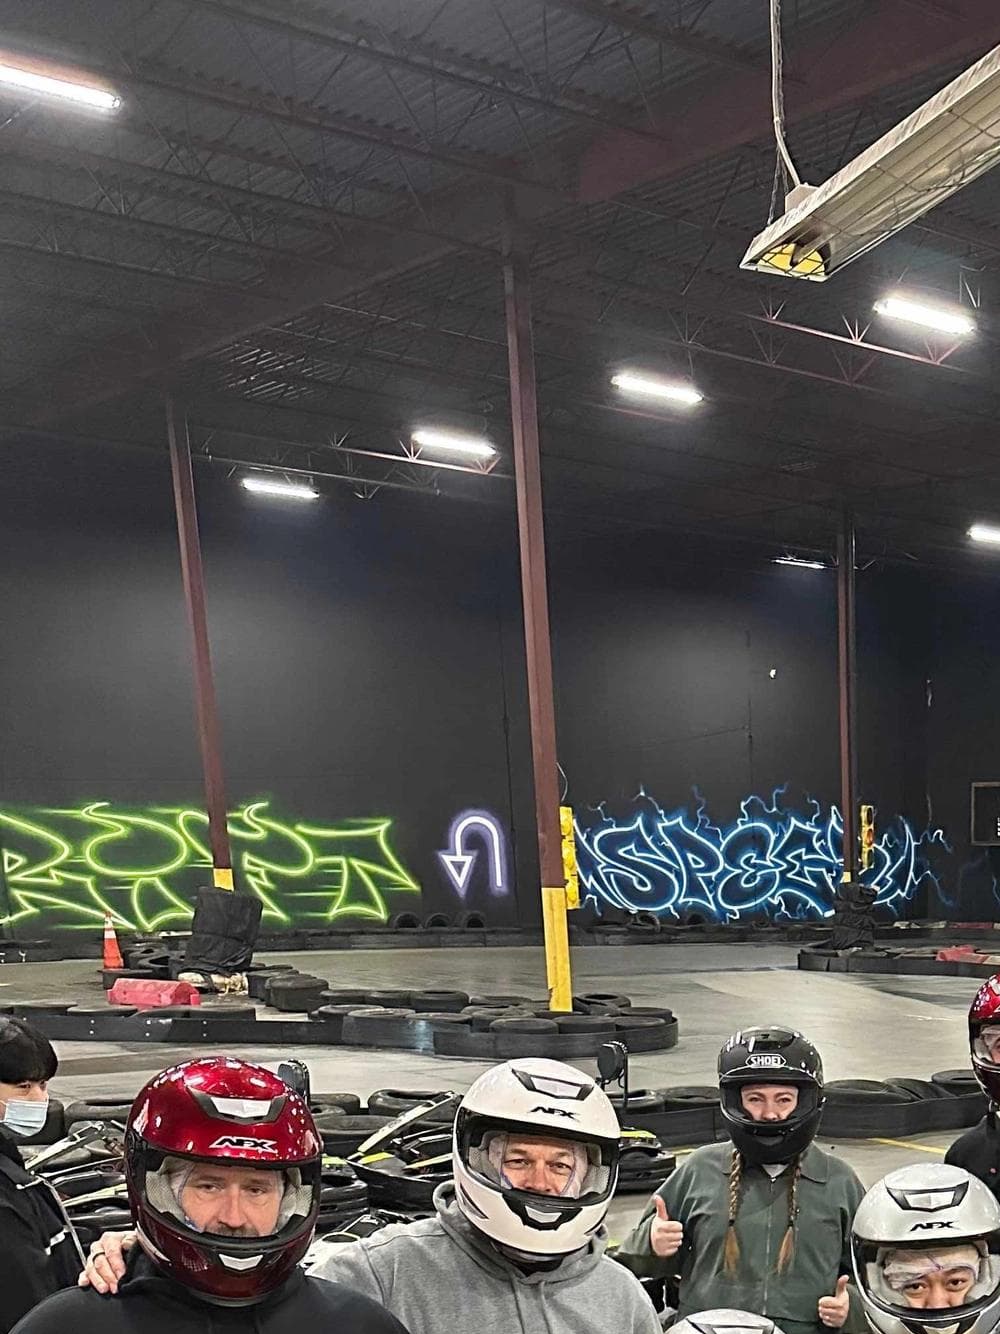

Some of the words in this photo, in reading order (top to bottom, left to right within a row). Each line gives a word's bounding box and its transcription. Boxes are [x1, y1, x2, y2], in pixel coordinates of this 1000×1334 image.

[750, 1056, 782, 1066] SHOEI
[529, 1106, 580, 1122] AFX
[209, 1136, 278, 1154] AFX
[910, 1220, 957, 1232] AFX
